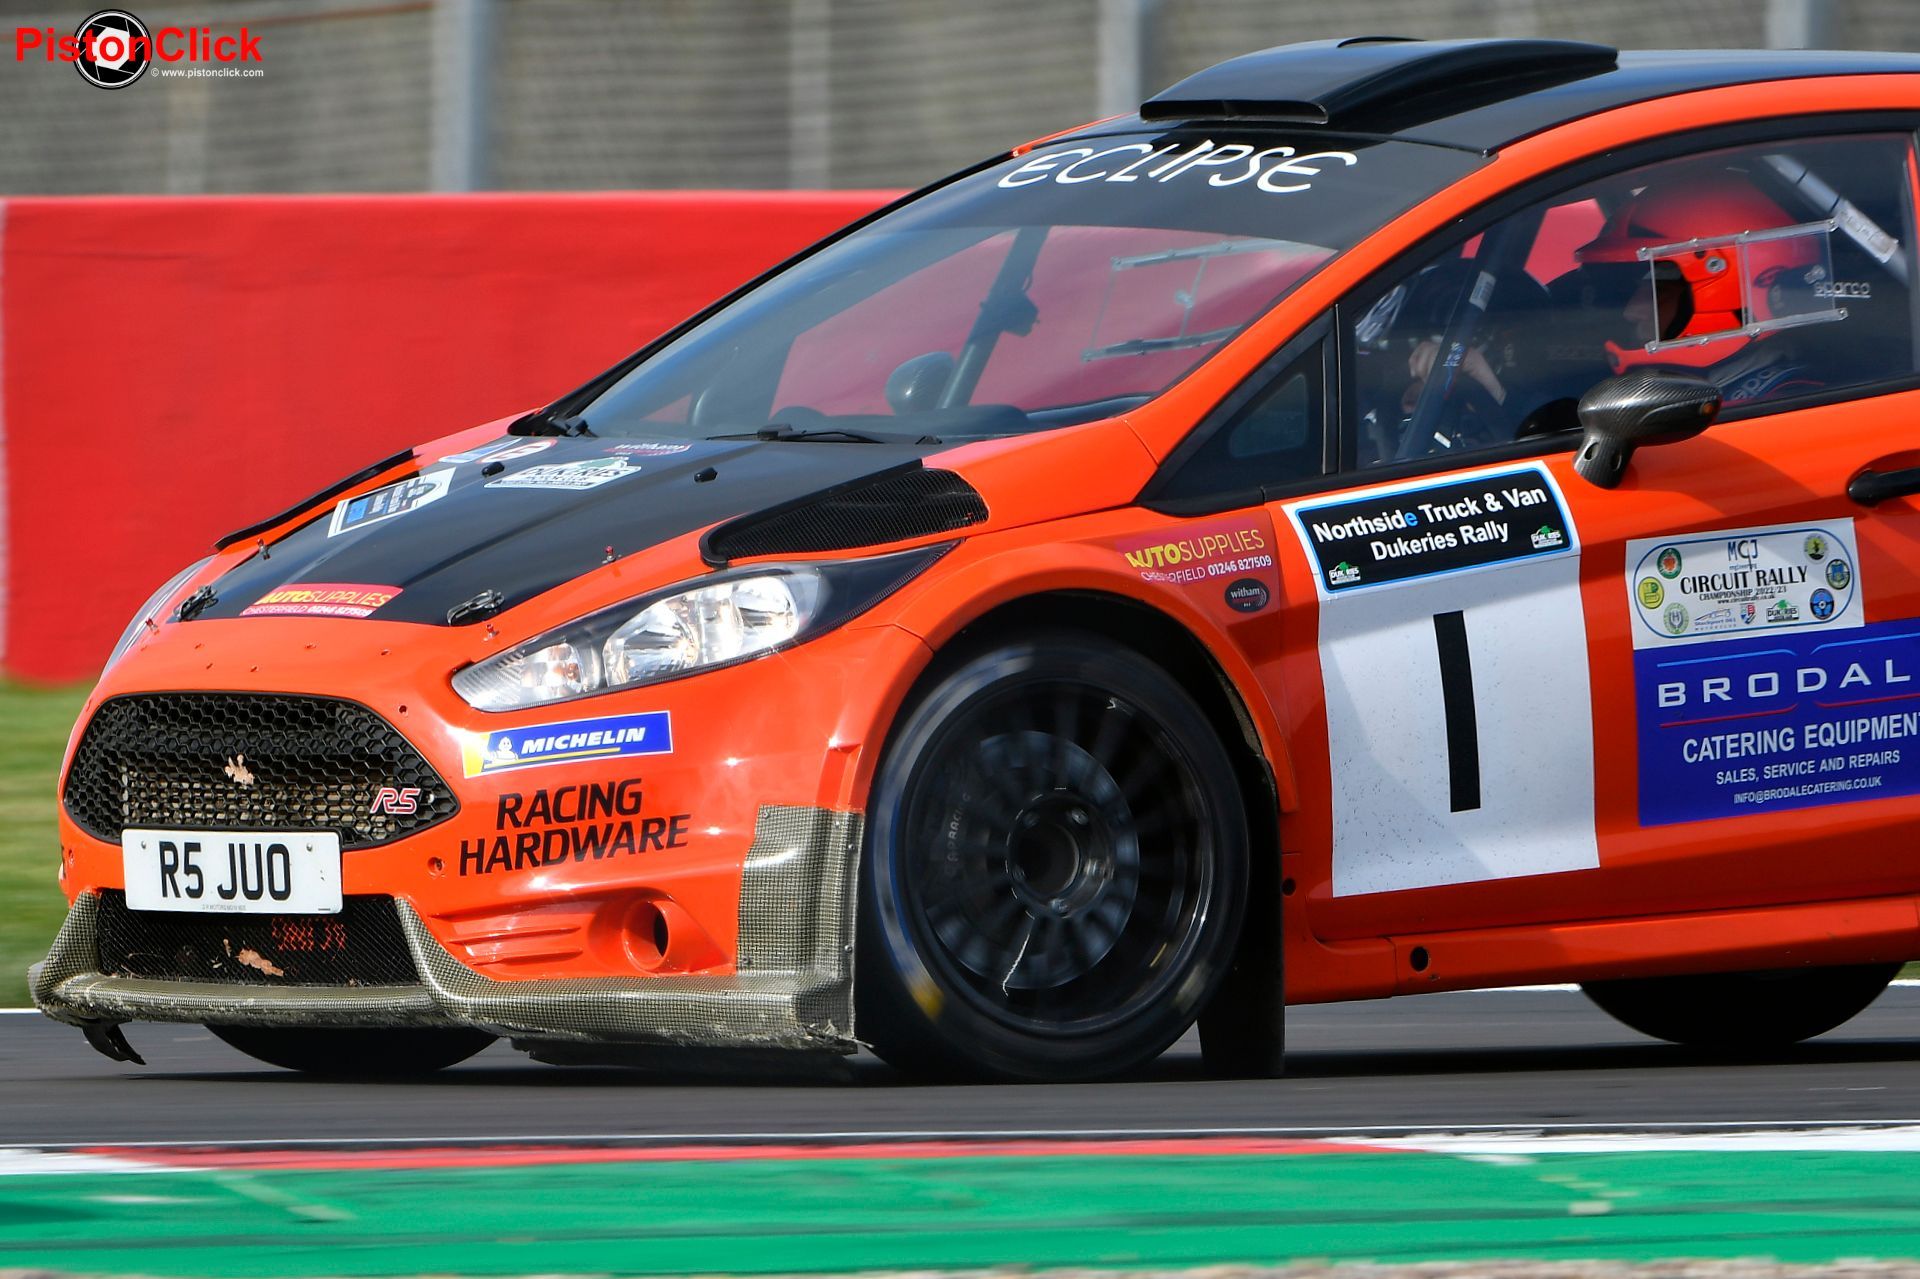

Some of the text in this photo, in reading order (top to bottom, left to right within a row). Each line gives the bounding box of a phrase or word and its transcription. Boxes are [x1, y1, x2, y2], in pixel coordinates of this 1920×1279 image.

[998, 139, 1358, 193] ECLIPSE
[1312, 488, 1547, 543] Northside Truck & Van
[1125, 529, 1265, 569] AUTOSUPPLIES
[1370, 521, 1509, 561] Dukeries Rally
[1208, 560, 1237, 576] 01246
[1238, 554, 1272, 571] 827509
[1680, 571, 1750, 595] CIRCUIT
[1756, 565, 1808, 588] RALLY
[253, 591, 392, 607] AUTOSUPPLIES
[1230, 586, 1260, 599] witham
[1699, 588, 1754, 601] CHAMPIONSHIP
[1658, 659, 1911, 708] BRODAL
[1433, 609, 1481, 813] 1
[521, 727, 646, 754] MICHELIN
[1683, 711, 1920, 763] CATERING EQUIPMEN
[1716, 750, 1901, 785] SALES, SERVICE AND REPAIRS
[496, 778, 642, 830] RACING
[1733, 776, 1882, 804] INFO@BRODALECATERING.CO.UK
[459, 814, 691, 876] HARDWARE
[159, 841, 292, 900] R5 JUO
